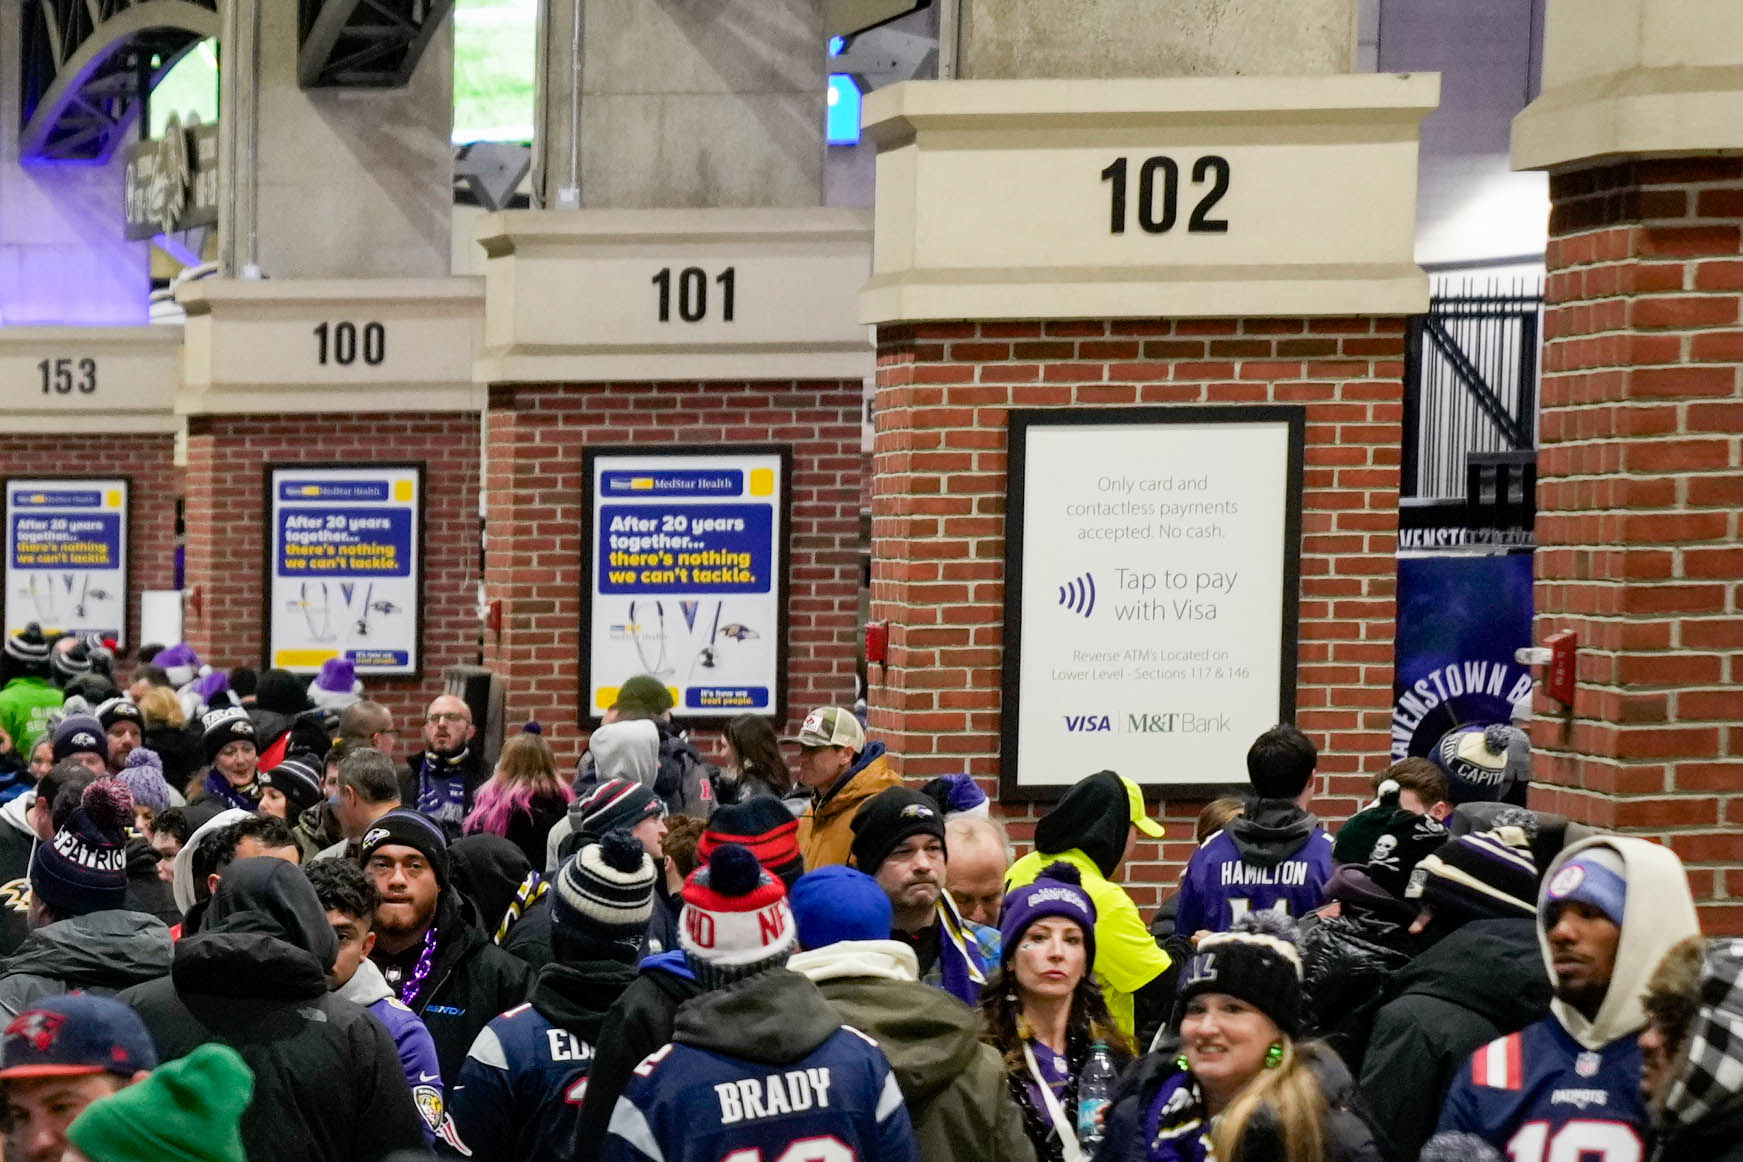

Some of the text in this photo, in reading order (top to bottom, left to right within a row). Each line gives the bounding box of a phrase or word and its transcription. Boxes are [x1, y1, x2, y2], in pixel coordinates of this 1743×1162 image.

[1100, 155, 1231, 235] 102
[651, 266, 736, 323] 101
[312, 321, 386, 365] 100
[37, 358, 97, 394] 153
[655, 478, 696, 489] MedStar
[698, 477, 732, 489] Health
[1097, 476, 1208, 494] Only card and
[1065, 501, 1239, 520] contactless payments
[285, 515, 391, 531] After 20 years
[609, 515, 745, 535] After 20 years
[285, 529, 360, 543] together...
[609, 533, 705, 552] together...
[1077, 525, 1225, 544] accepted. No cash.
[338, 543, 396, 558] nothing
[609, 550, 752, 569] there's nothing
[285, 556, 398, 569] we can't tackle.
[608, 567, 757, 583] we can't tackle.
[1115, 568, 1238, 594] Tap to pay
[1115, 598, 1218, 622] with Visa
[1073, 649, 1120, 662] Reverse
[1160, 649, 1210, 662] Located
[1213, 651, 1229, 662] on
[1052, 668, 1089, 681] Lower
[1092, 667, 1124, 681] Level
[1135, 667, 1187, 681] Sections
[1214, 667, 1224, 680] &
[1228, 667, 1250, 680] 146
[1391, 661, 1508, 765] AVENSTOWN
[1064, 715, 1111, 732] VISA
[1127, 713, 1231, 733] M&T Bank
[1220, 860, 1307, 887] HAMILTON
[714, 1067, 832, 1125] BRADY
